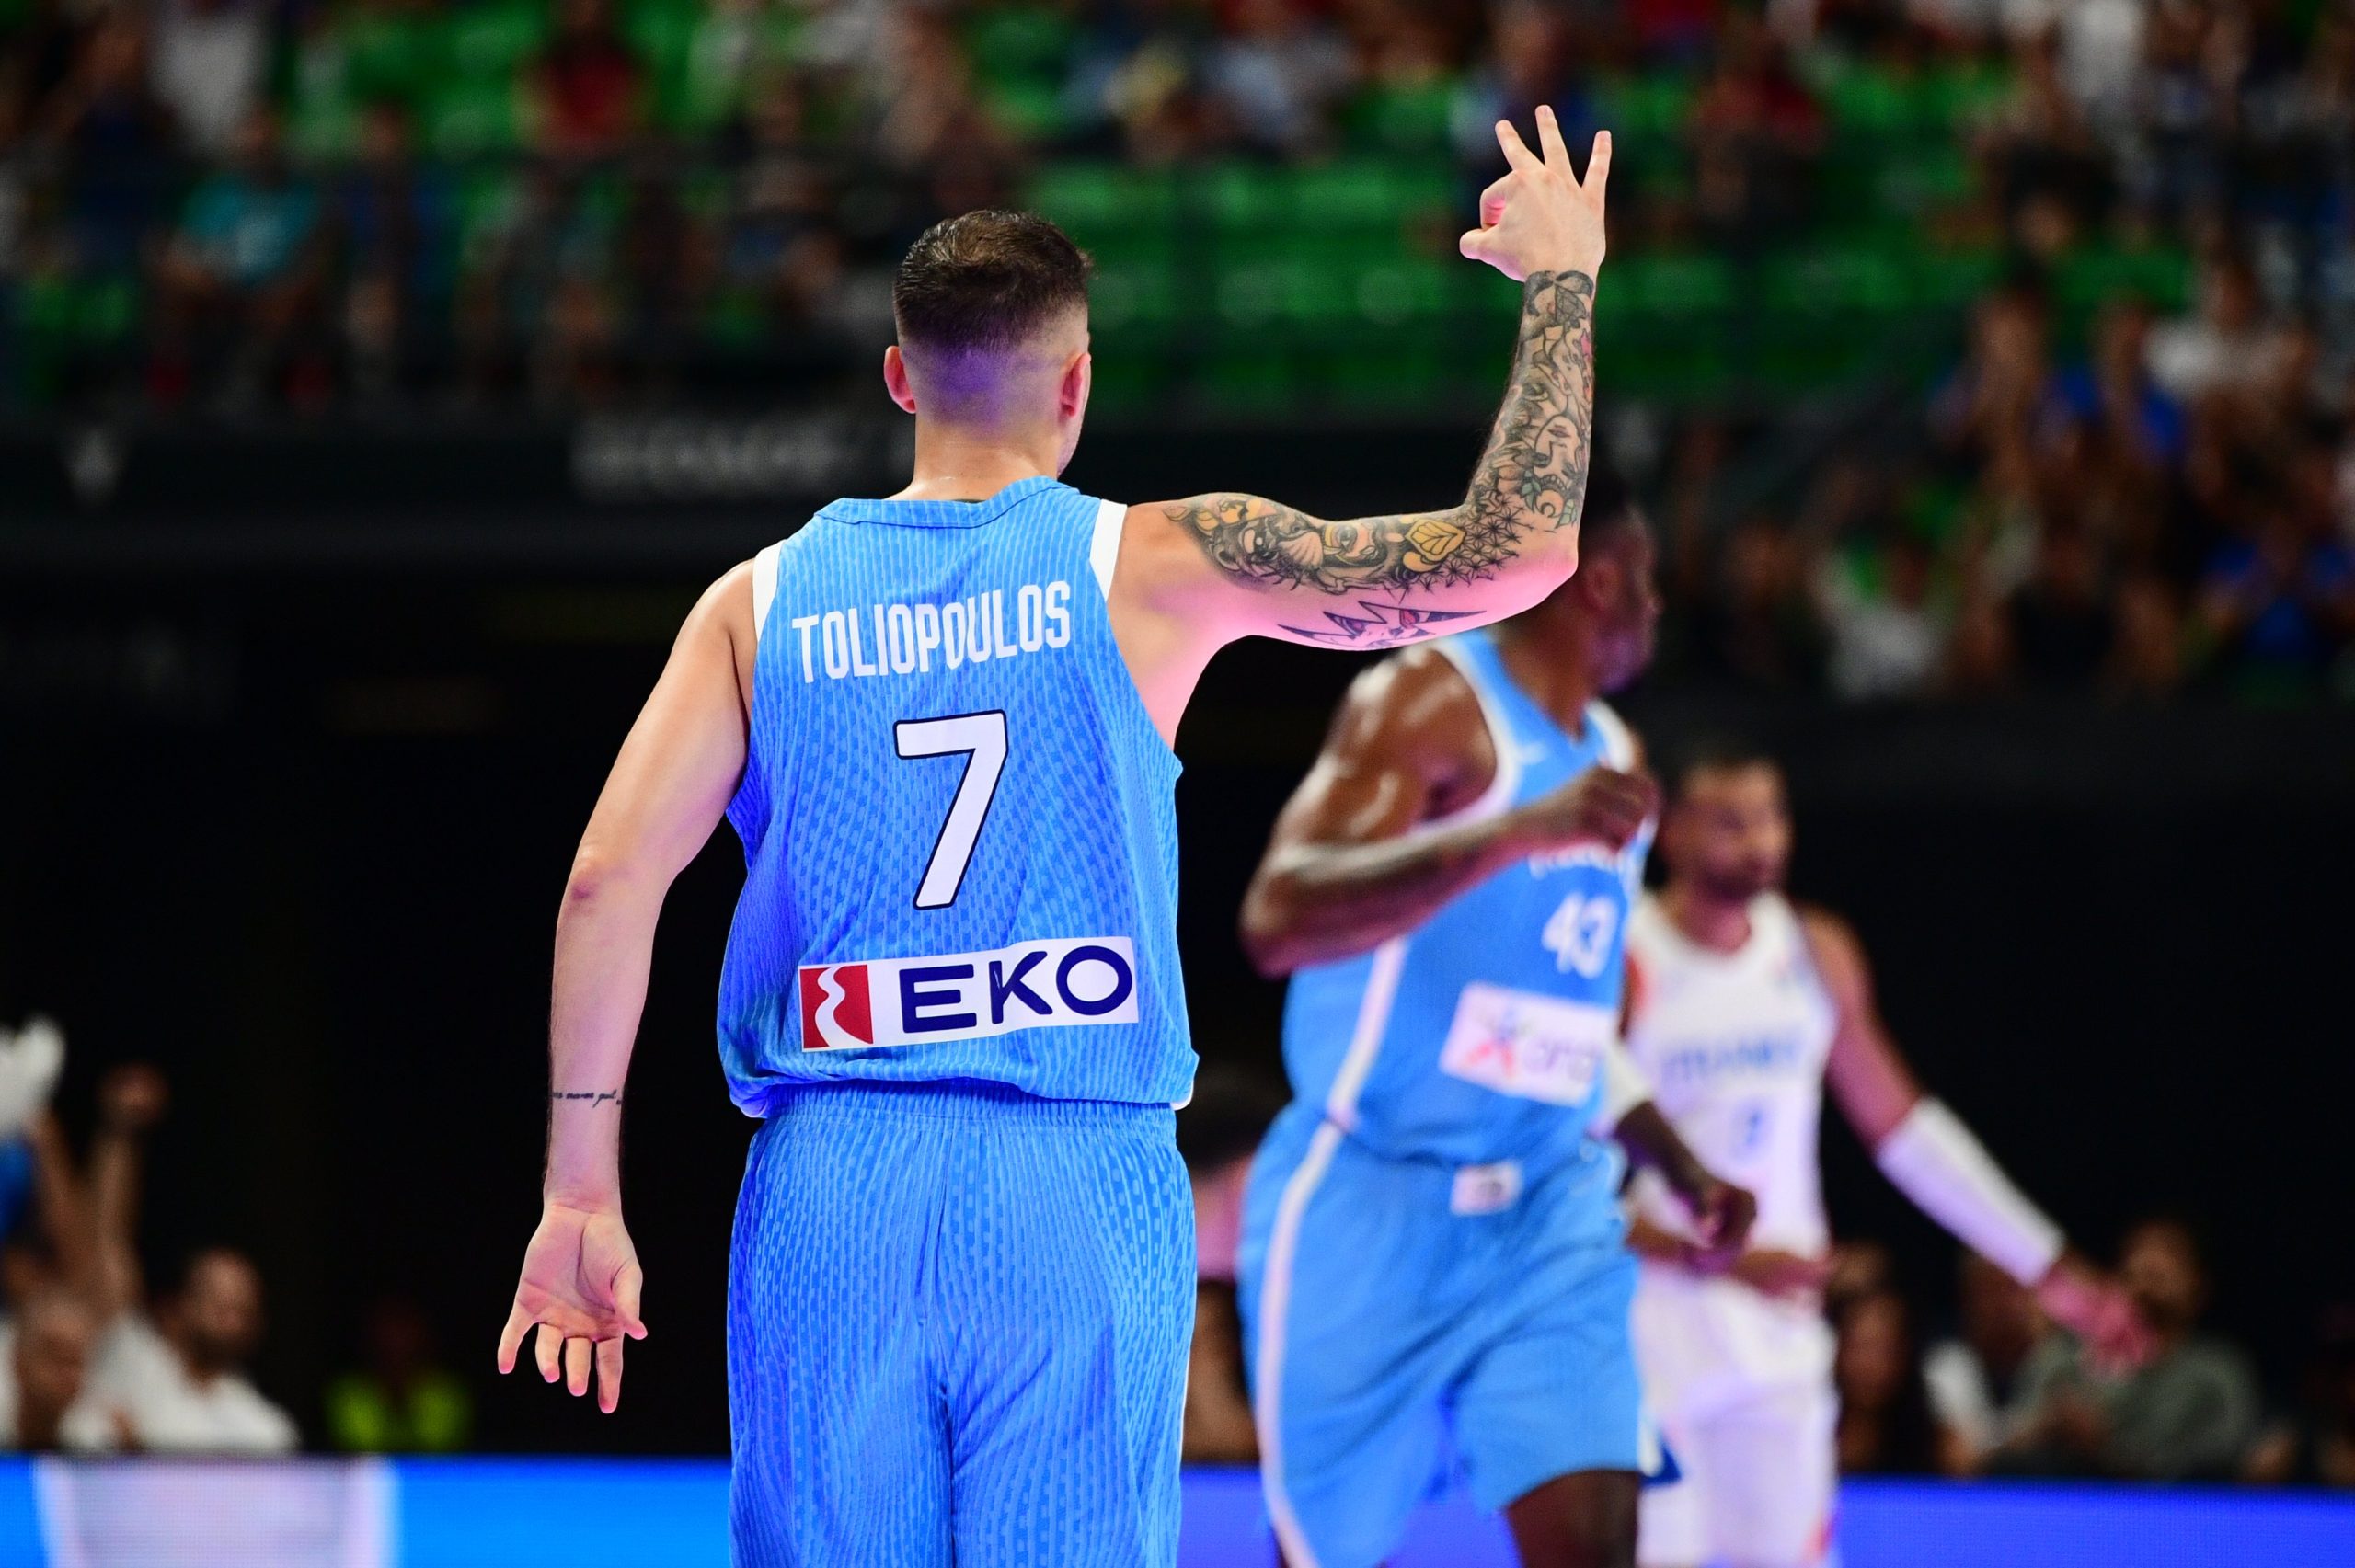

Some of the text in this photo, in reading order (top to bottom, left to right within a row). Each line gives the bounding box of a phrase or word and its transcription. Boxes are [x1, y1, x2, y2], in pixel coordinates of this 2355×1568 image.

[792, 580, 1071, 683] TOLIOPOULOS
[893, 709, 1008, 910] 7
[1542, 891, 1618, 979] 43
[899, 945, 1132, 1034] EKO
